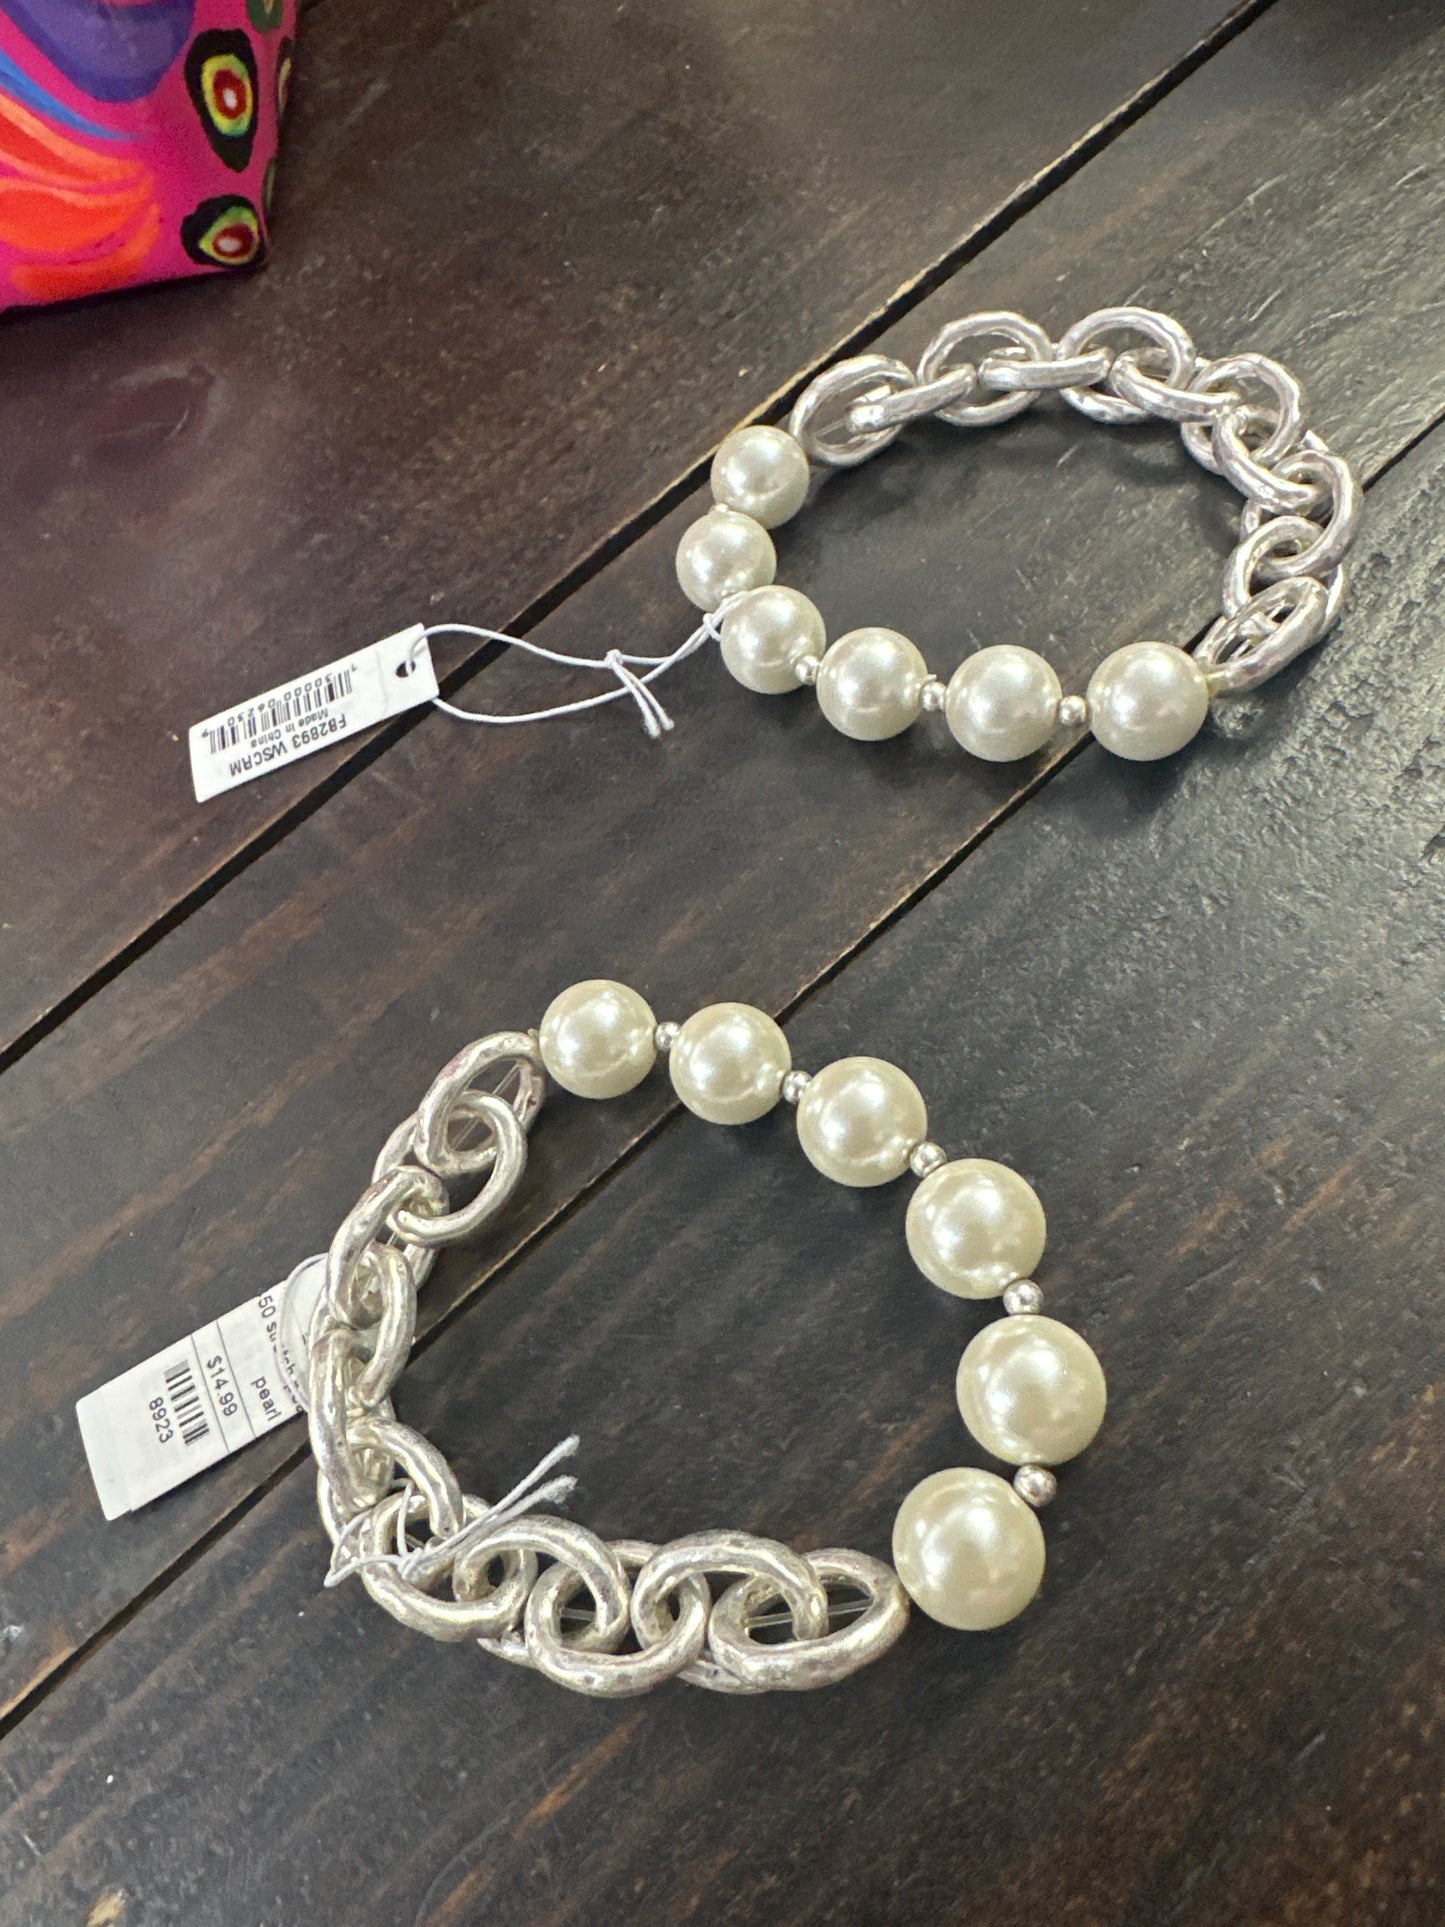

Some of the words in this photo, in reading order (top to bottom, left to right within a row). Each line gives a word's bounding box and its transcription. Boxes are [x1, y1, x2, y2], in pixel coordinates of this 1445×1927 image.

[293, 714, 347, 748] FB2893
[298, 708, 329, 728] Made
[251, 729, 281, 748] China
[230, 741, 287, 777] WSCRM
[207, 1355, 238, 1417] $14.99
[251, 1376, 282, 1421] pearl
[149, 1396, 174, 1444] 8923
